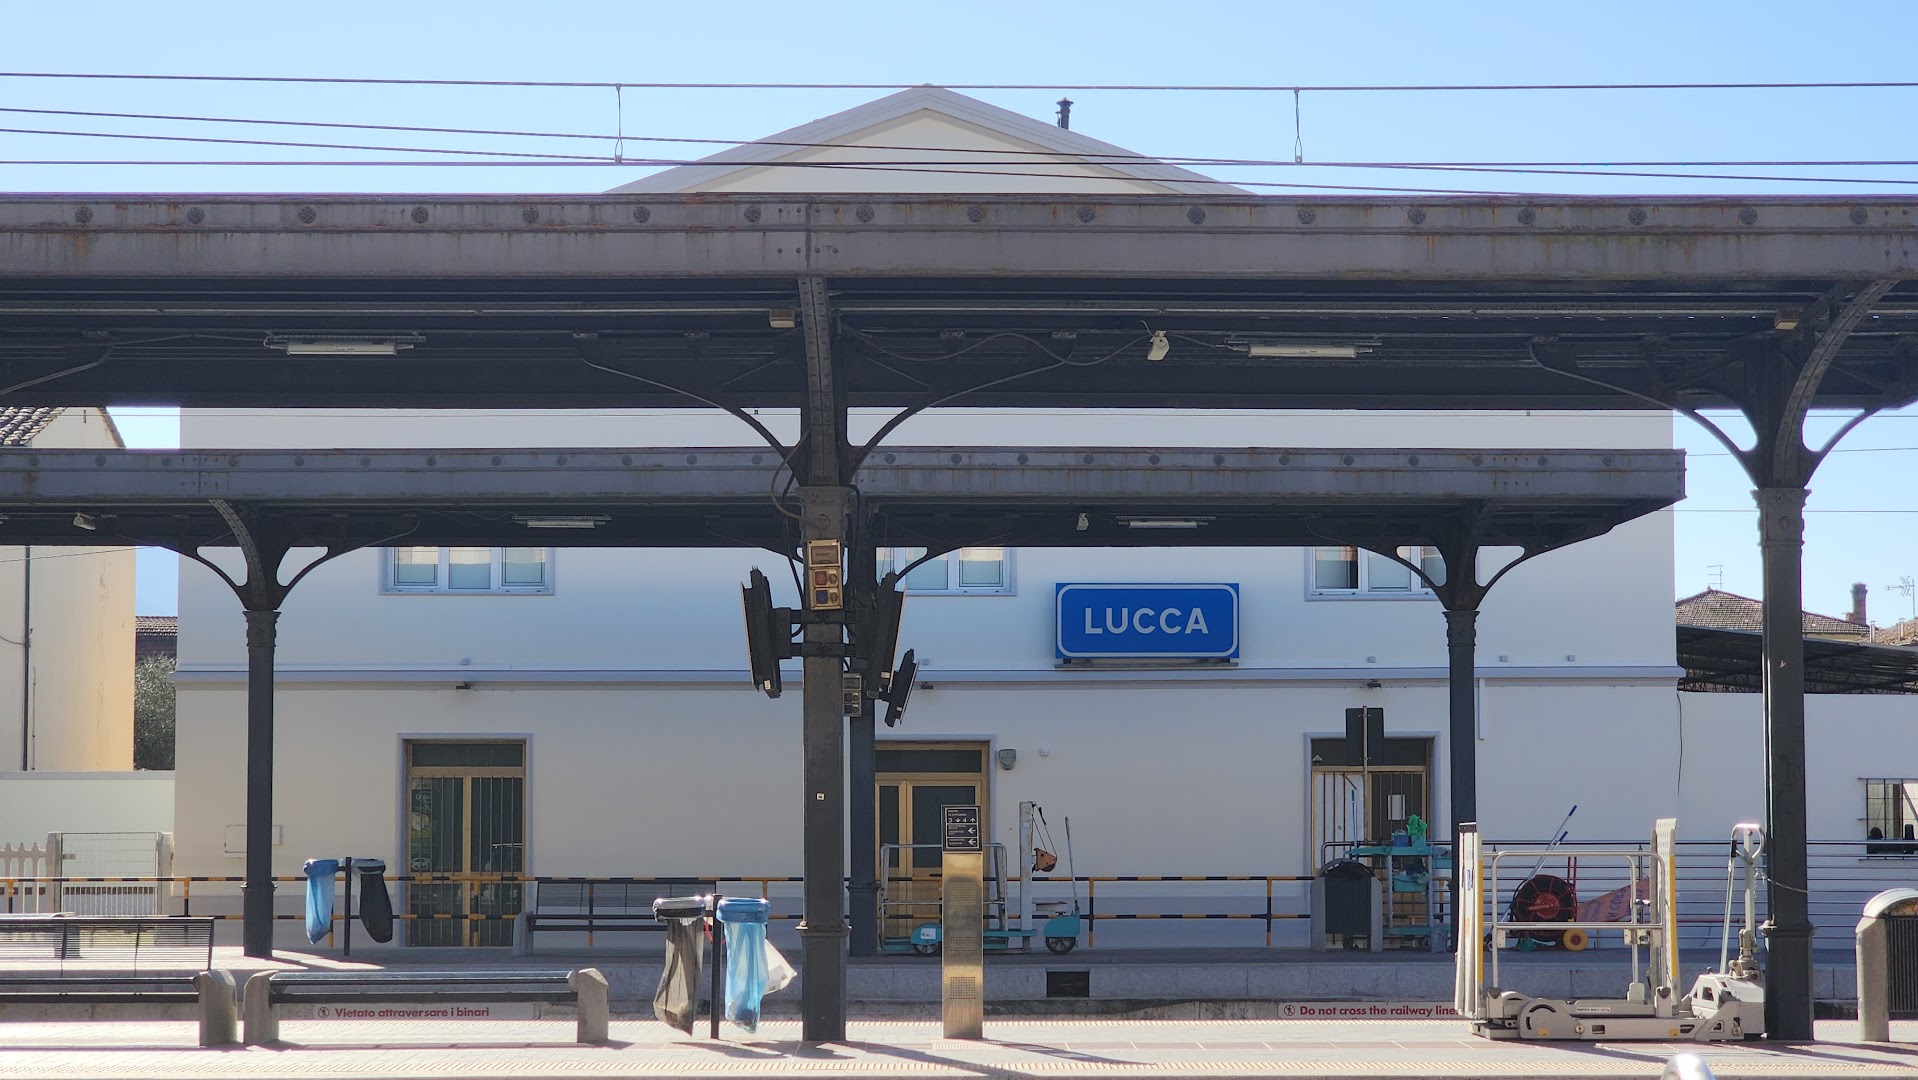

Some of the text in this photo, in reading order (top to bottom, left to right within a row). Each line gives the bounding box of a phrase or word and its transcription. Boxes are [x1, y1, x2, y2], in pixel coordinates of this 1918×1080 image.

[1084, 607, 1209, 634] LUCCA
[334, 1006, 490, 1018] Vietato attraversare i binari
[1299, 1005, 1316, 1016] Do
[1318, 1006, 1337, 1016] not
[1338, 1007, 1367, 1016] cross
[1369, 1004, 1388, 1016] the
[1390, 1004, 1434, 1018] railway
